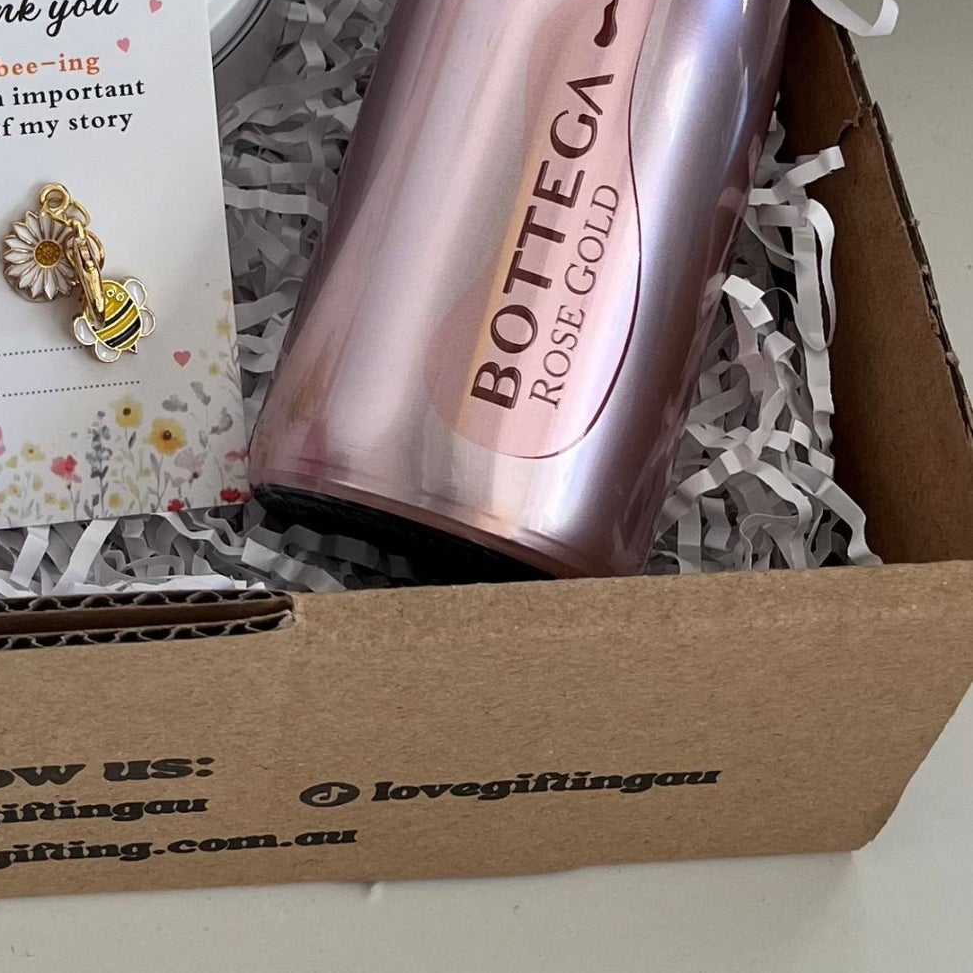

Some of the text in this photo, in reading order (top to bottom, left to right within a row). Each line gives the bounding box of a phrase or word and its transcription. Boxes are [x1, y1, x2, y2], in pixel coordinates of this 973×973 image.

[12, 79, 146, 109] important
[19, 118, 60, 139] my
[68, 111, 133, 132] story
[470, 73, 614, 409] BOTTEGA
[529, 183, 620, 410] ROSE GOLD
[101, 756, 215, 784] us:
[371, 769, 723, 802] lovegiftingau
